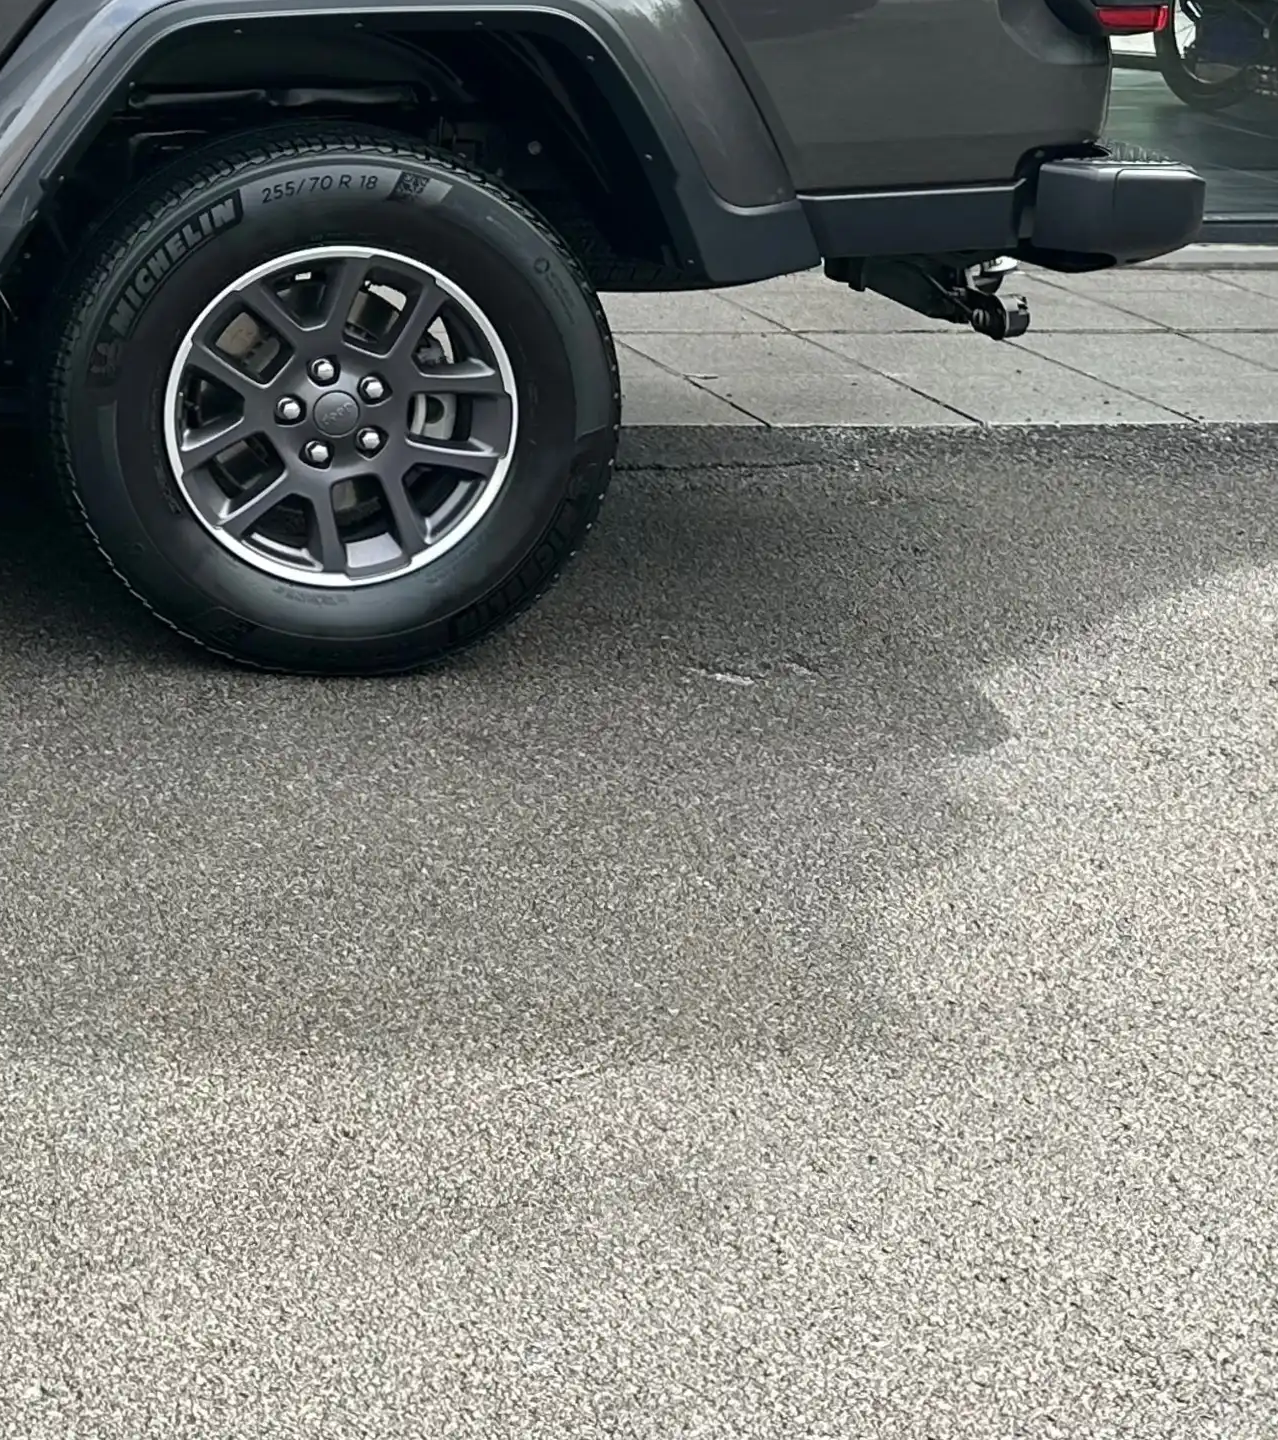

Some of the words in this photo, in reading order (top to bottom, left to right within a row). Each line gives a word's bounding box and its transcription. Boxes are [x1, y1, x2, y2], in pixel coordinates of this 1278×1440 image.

[108, 198, 237, 335] MICHELIN
[261, 174, 333, 204] 255/70
[338, 173, 352, 190] R
[360, 174, 378, 190] 18
